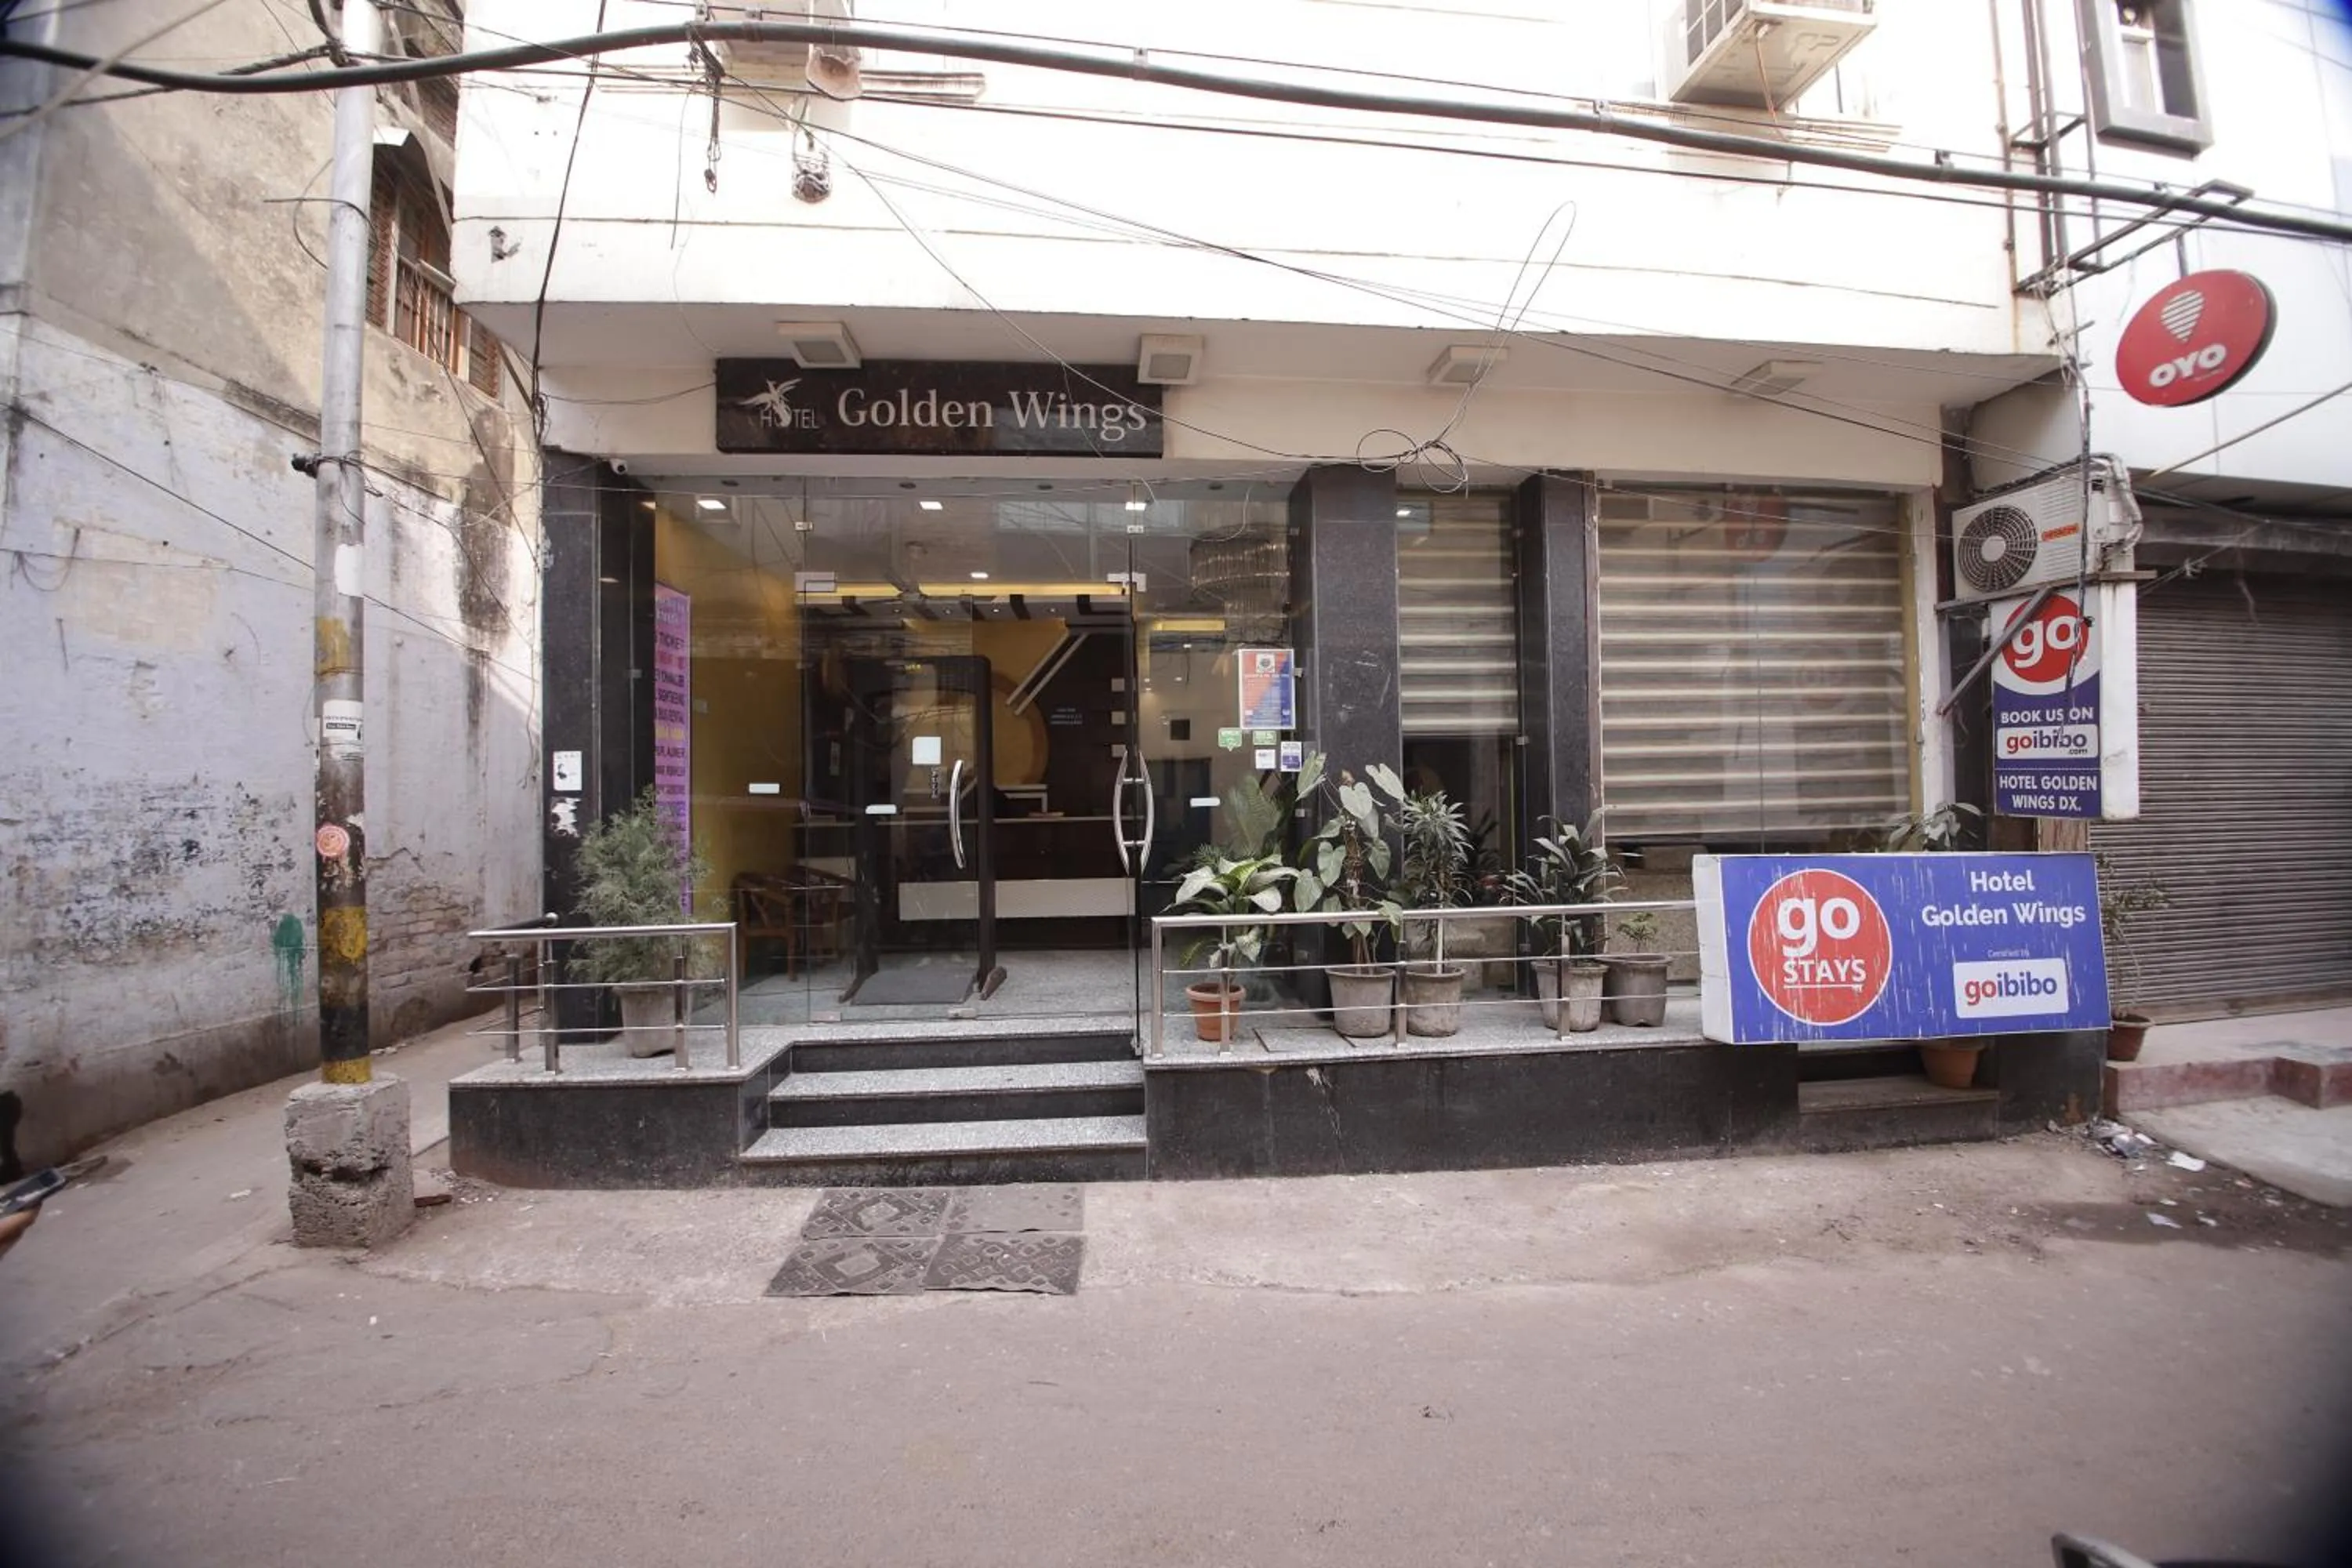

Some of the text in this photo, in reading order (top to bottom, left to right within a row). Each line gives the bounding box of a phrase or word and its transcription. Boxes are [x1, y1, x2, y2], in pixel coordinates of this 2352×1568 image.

[2148, 343, 2227, 387] OYO
[838, 388, 993, 427] Golden
[1008, 390, 1147, 441] Wings
[2012, 615, 2079, 668] go
[2000, 707, 2094, 723] BOOK US ON
[2006, 730, 2087, 754] goibibo
[1999, 775, 2097, 791] HOTEL GOLDEN
[2012, 794, 2082, 812] WINGS DX.
[1970, 869, 2035, 892] Hotel
[1777, 897, 1860, 957] go
[1922, 902, 2086, 928] Golden Wings
[1783, 959, 1867, 984] STAYS
[1965, 971, 2057, 1007] goibibo
